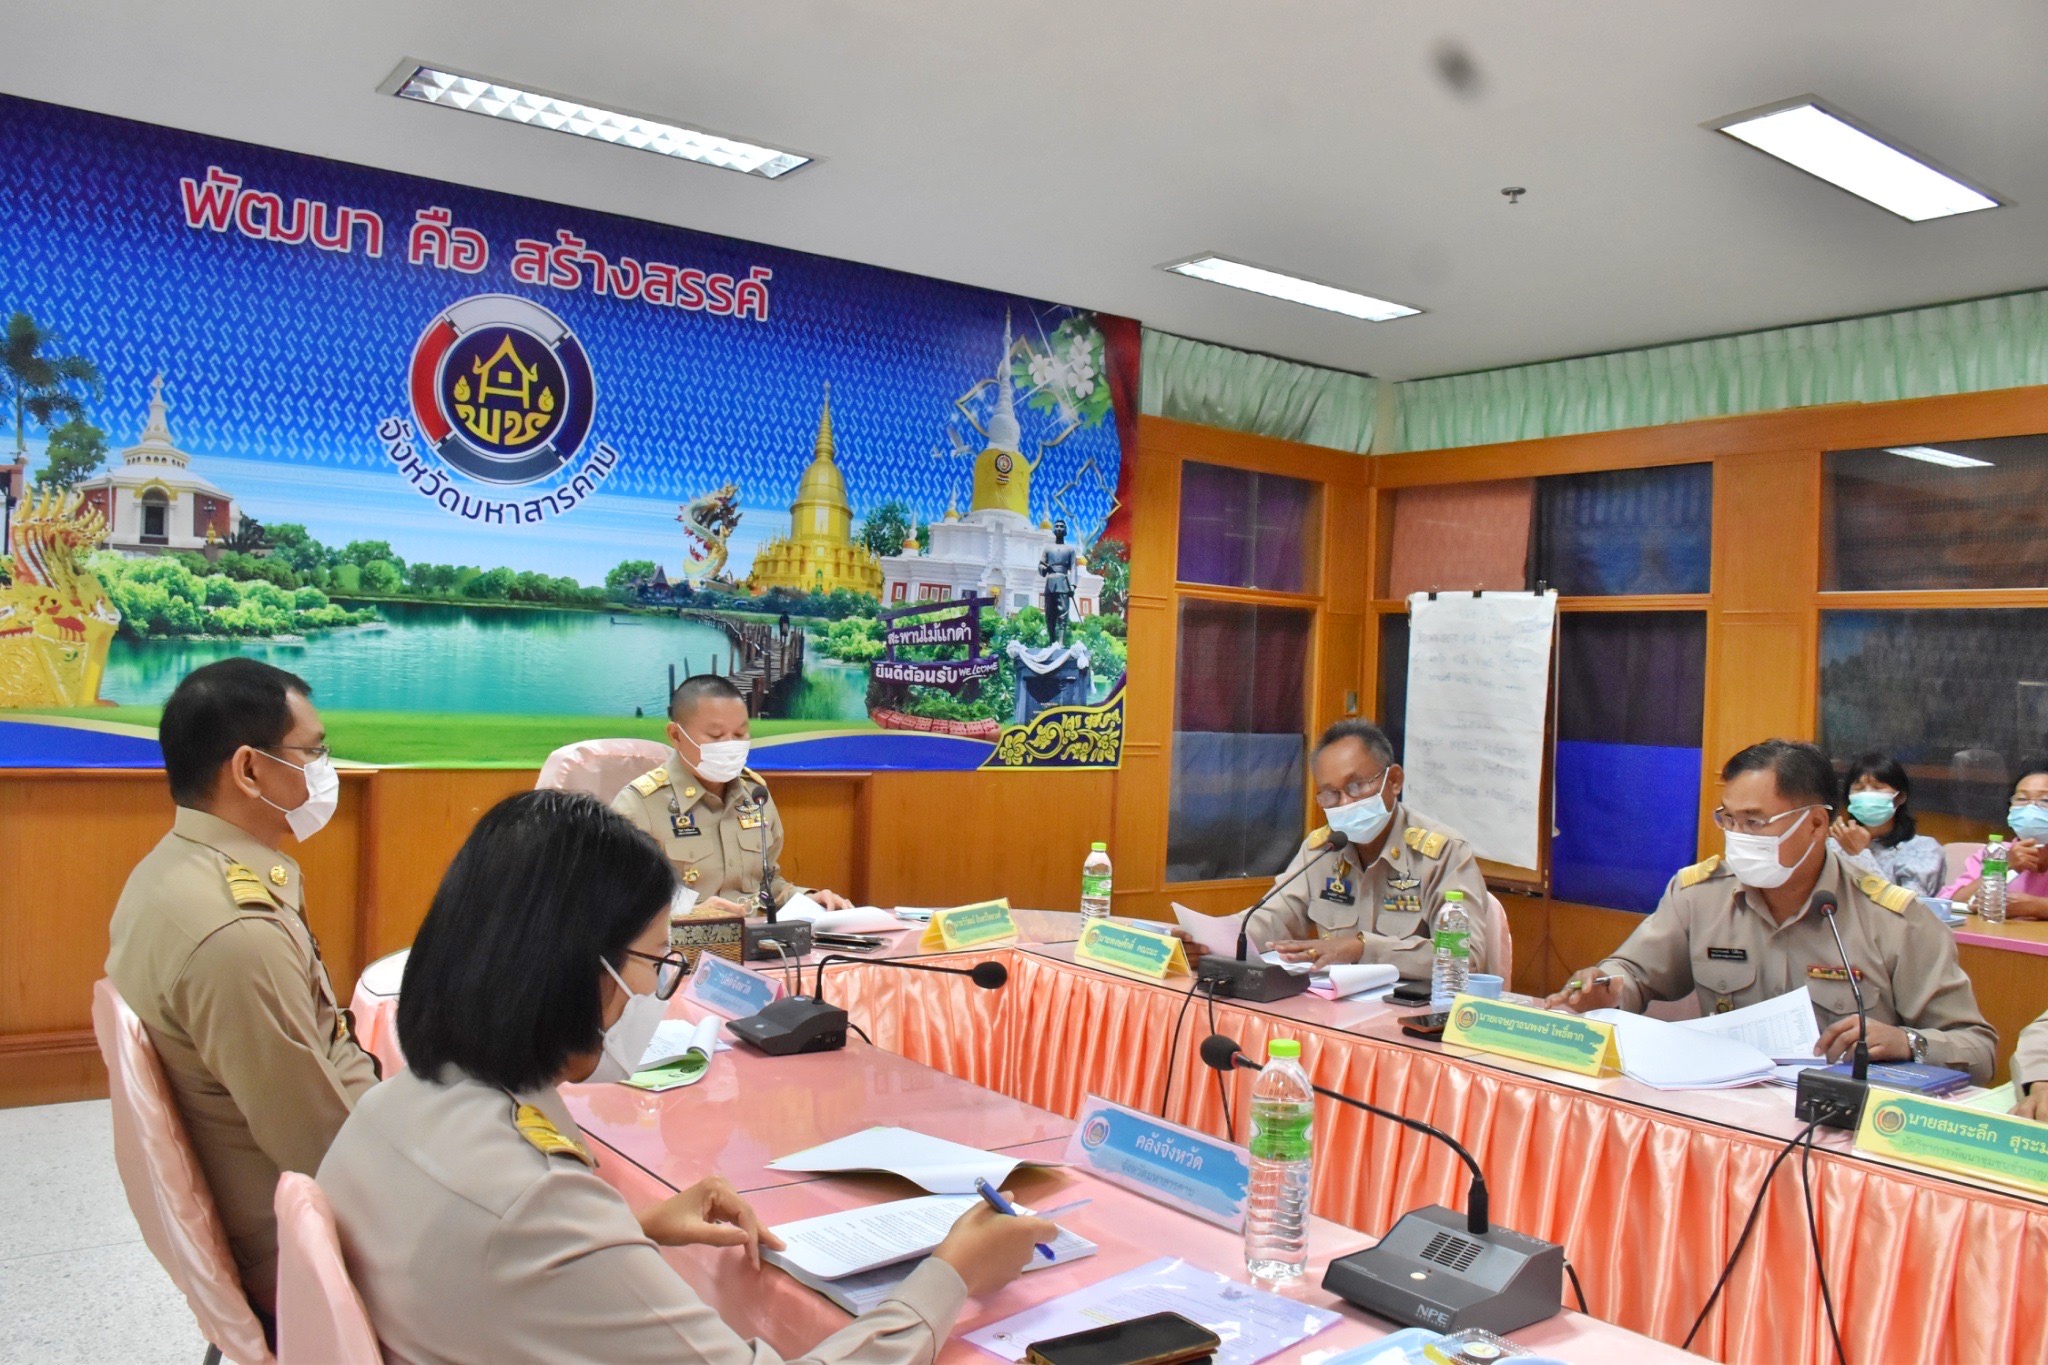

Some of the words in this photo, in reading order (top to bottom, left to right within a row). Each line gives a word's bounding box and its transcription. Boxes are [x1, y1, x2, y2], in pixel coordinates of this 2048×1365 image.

[180, 166, 384, 257] พัฒนา
[408, 206, 489, 274] คือ
[511, 229, 773, 322] สร้างสรรค์
[379, 418, 616, 525] จังหวัดมหาสารคาม
[887, 622, 972, 645] สะพานไม้แกดำ
[875, 664, 958, 684] ยินดีต้อนรับ
[1908, 1112, 1998, 1143] นายสมระลึก
[1135, 1131, 1204, 1171] คลังจังหวัด
[1416, 1304, 1450, 1325] NPE
